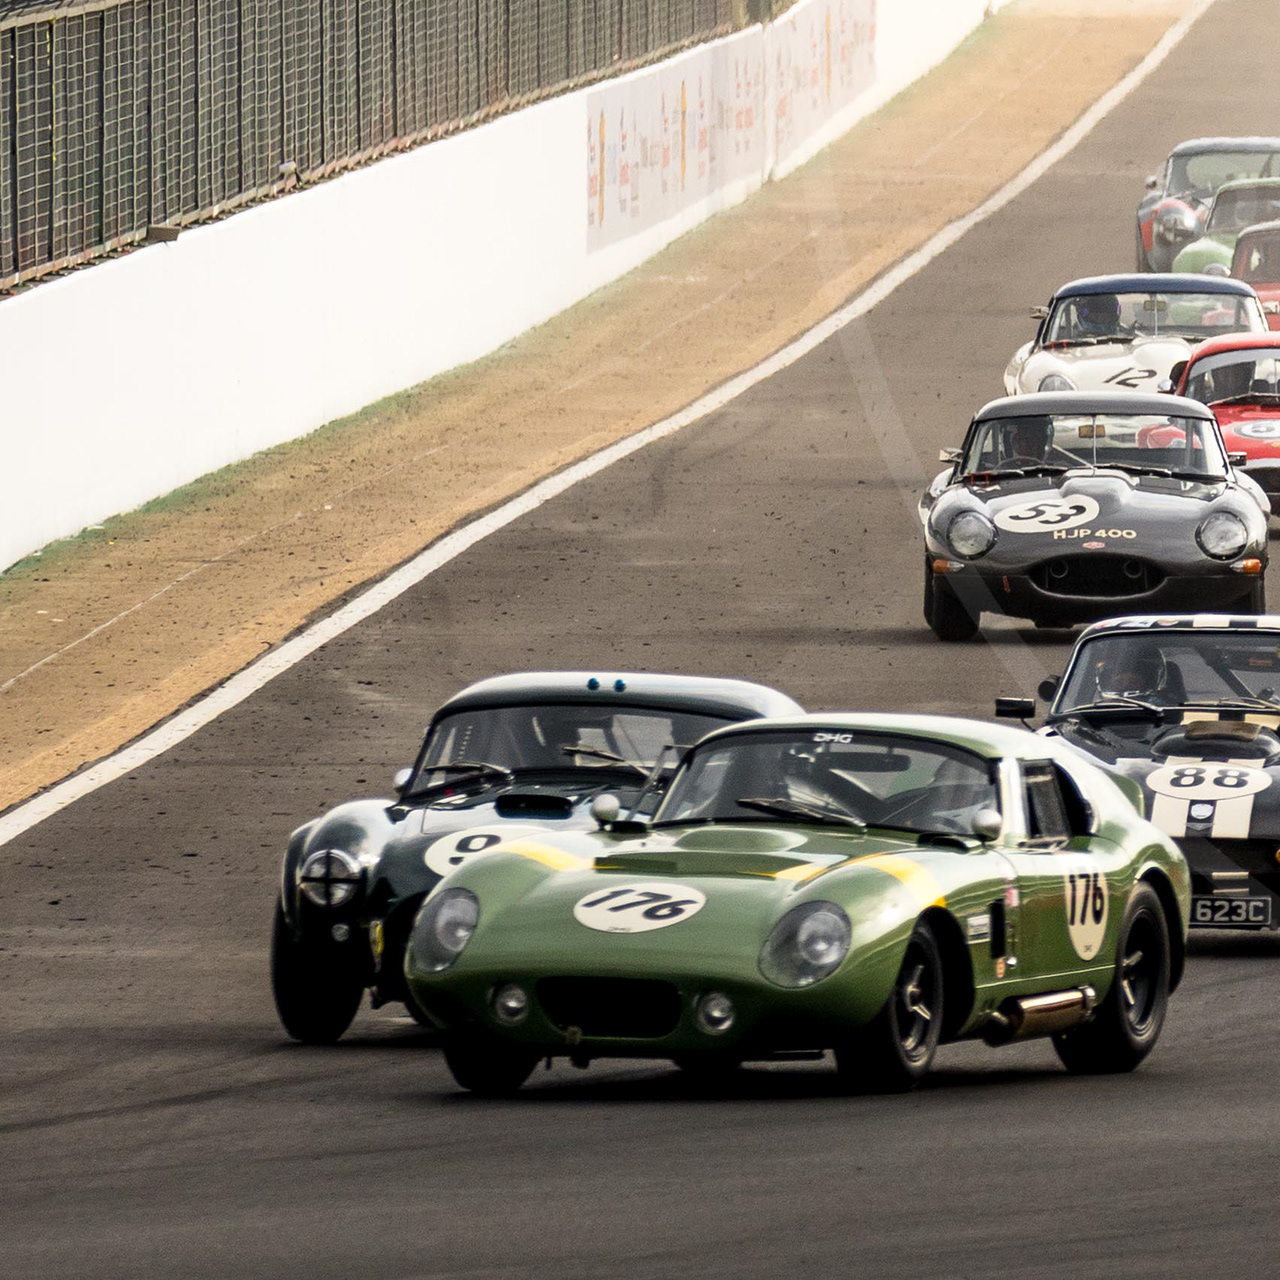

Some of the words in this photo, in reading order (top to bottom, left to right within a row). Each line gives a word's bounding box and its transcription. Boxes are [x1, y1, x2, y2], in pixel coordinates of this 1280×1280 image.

[1103, 367, 1158, 388] 12
[1009, 503, 1087, 525] 53
[1053, 529, 1091, 540] HJP
[1095, 529, 1137, 539] 400
[813, 733, 854, 744] DHG
[1169, 767, 1250, 789] 88
[582, 888, 698, 922] 176
[1069, 868, 1104, 926] 176
[1196, 900, 1264, 922] 623C
